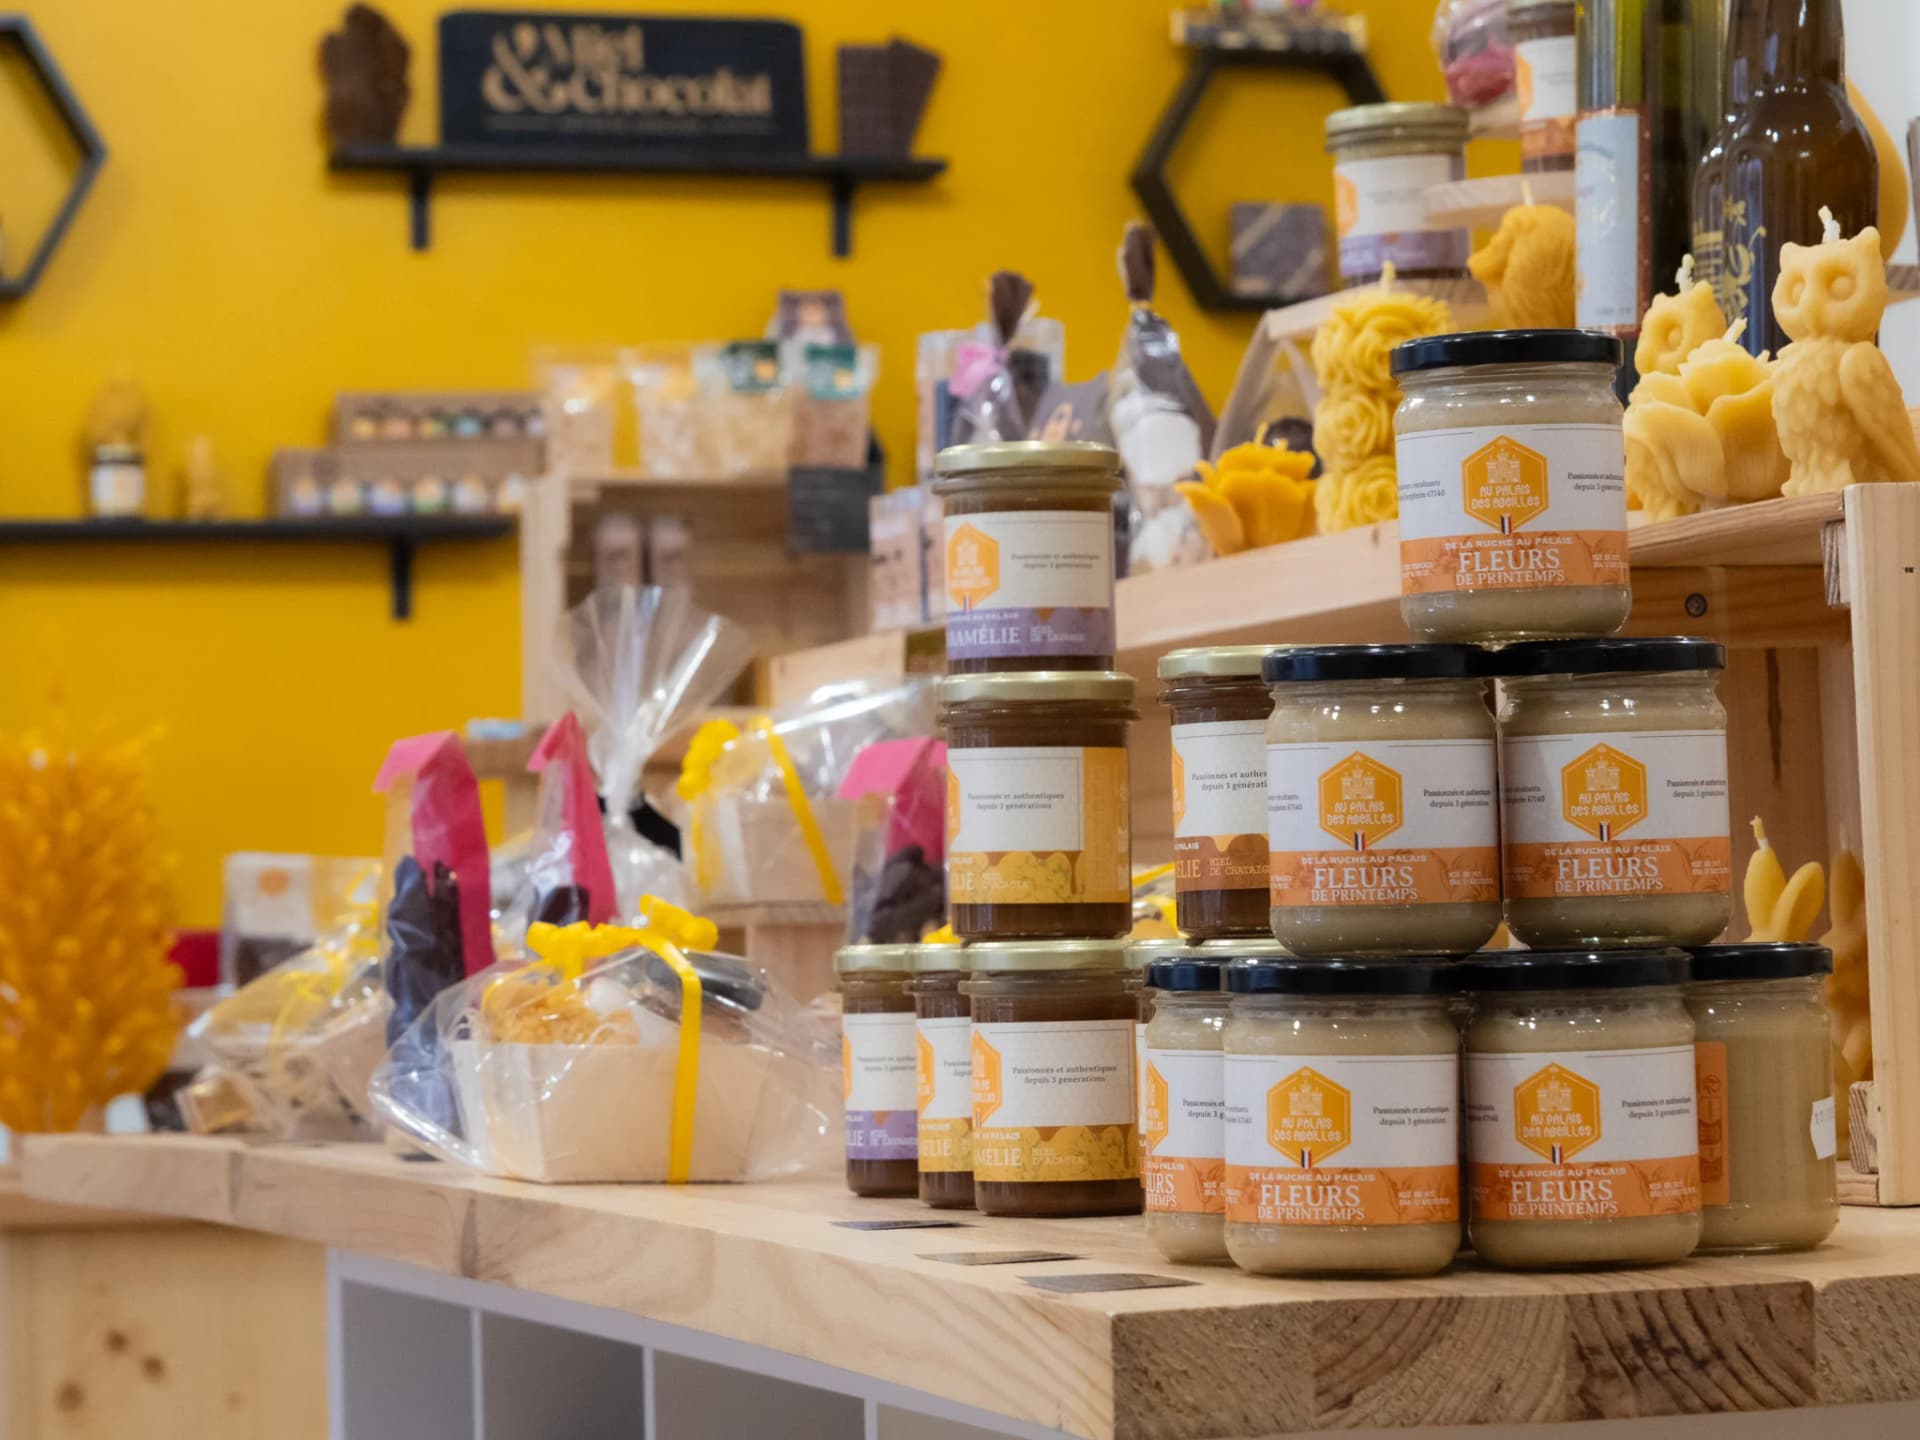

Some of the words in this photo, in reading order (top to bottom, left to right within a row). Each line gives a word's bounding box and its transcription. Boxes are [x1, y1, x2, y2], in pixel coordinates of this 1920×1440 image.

[1495, 484, 1531, 496] PALAIS
[1536, 536, 1573, 545] PALAIS
[1458, 548, 1561, 573] FLEURS
[1456, 574, 1473, 587] DE
[1478, 569, 1566, 585] PRINTEMPS
[1594, 791, 1630, 803] PALAIS
[1350, 800, 1385, 812] PALAIS
[1633, 845, 1671, 853] PALAIS
[1388, 855, 1427, 863] PALAIS
[1557, 856, 1659, 881] FLEURS
[1313, 866, 1414, 889] FLEURS
[1556, 881, 1574, 893] DE
[1576, 877, 1664, 893] PRINTEMPS
[1311, 889, 1328, 901] DE
[1332, 887, 1418, 901] PRINTEMPS
[1298, 1116, 1333, 1130] PALAIS
[1546, 1113, 1582, 1126] PALAIS
[1335, 1173, 1376, 1182] PALAIS
[1587, 1167, 1627, 1176] PALAIS
[1260, 1183, 1361, 1207] FLEURS
[1510, 1178, 1614, 1203] FLEURS
[1257, 1206, 1273, 1220] DE
[1277, 1206, 1366, 1222] PRINTEMPS
[1508, 1203, 1526, 1217] DE
[1530, 1200, 1619, 1216] PRINTEMPS
